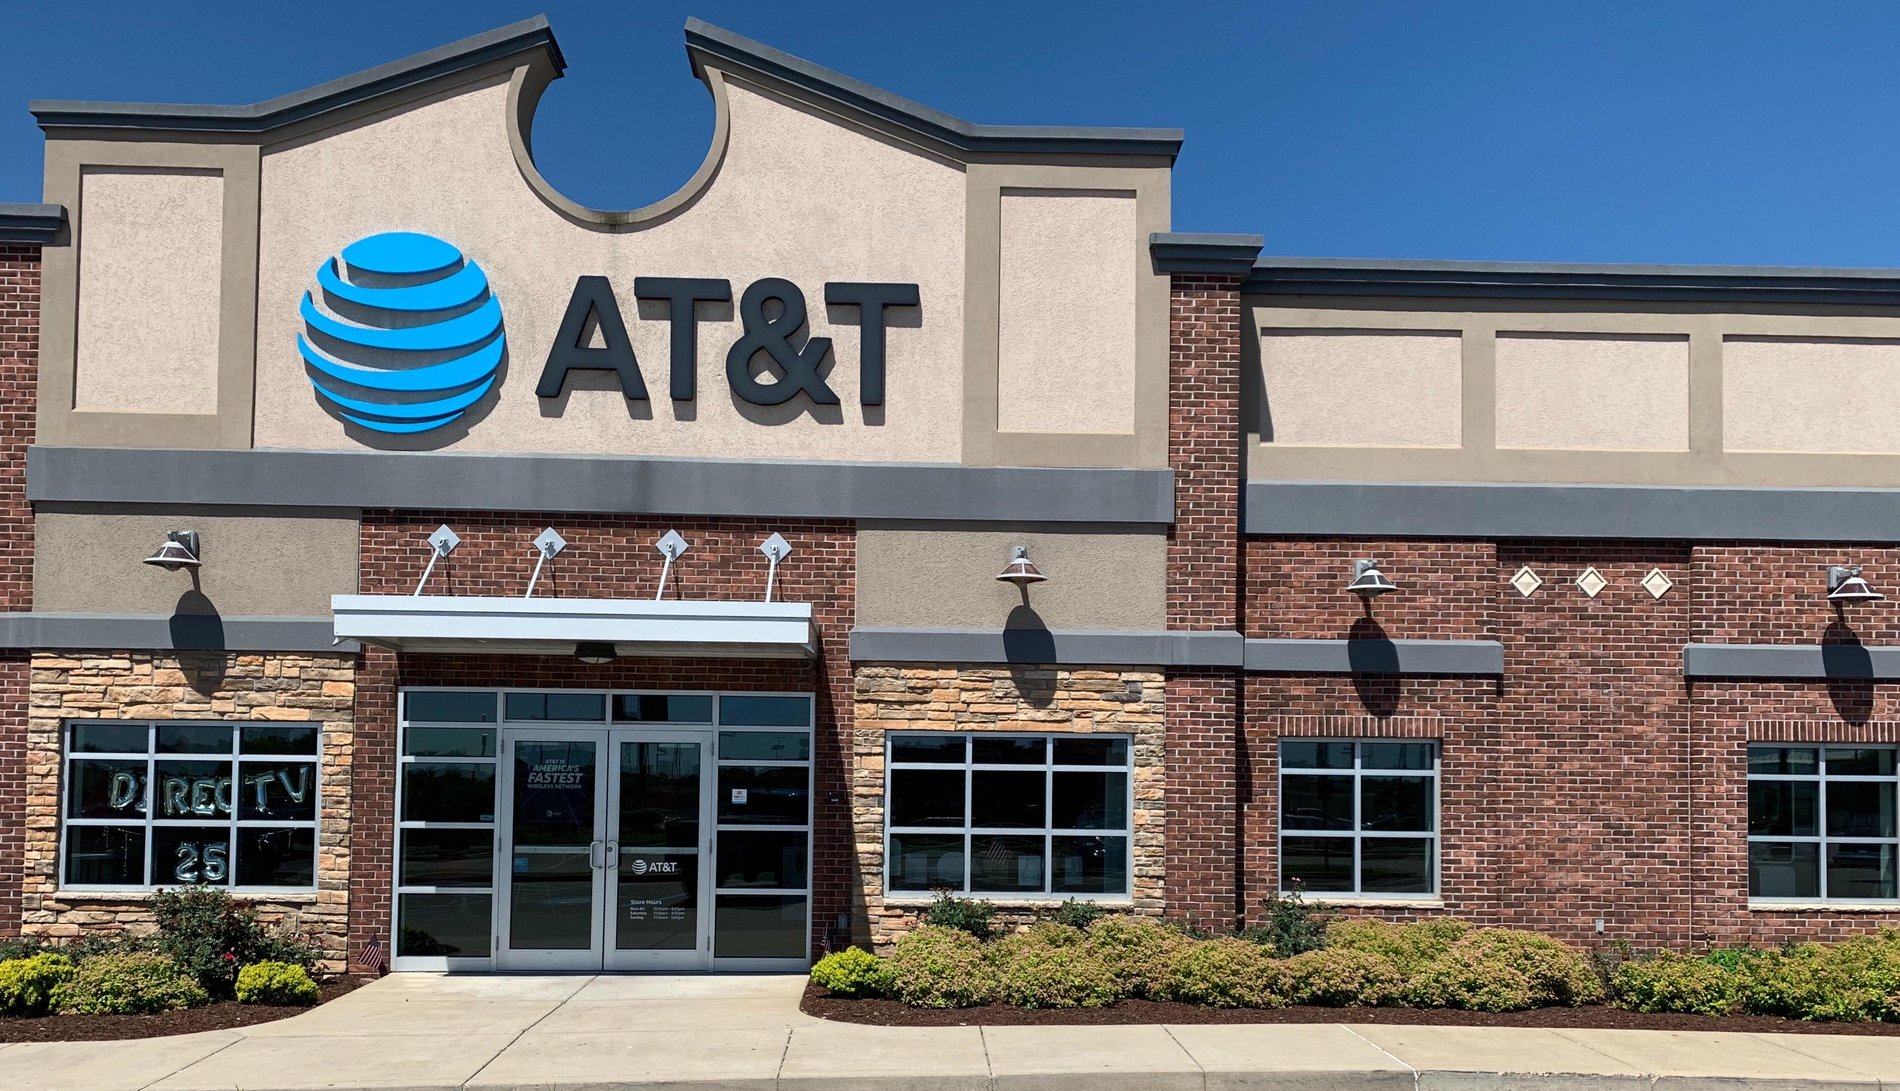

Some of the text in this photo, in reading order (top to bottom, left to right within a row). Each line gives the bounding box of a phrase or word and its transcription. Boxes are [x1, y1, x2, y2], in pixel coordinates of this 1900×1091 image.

[535, 275, 919, 406] AT&T
[532, 764, 580, 772] AMERICA'S
[527, 772, 584, 783] FASTEST
[176, 842, 228, 881] 25
[649, 862, 677, 872] AT&T
